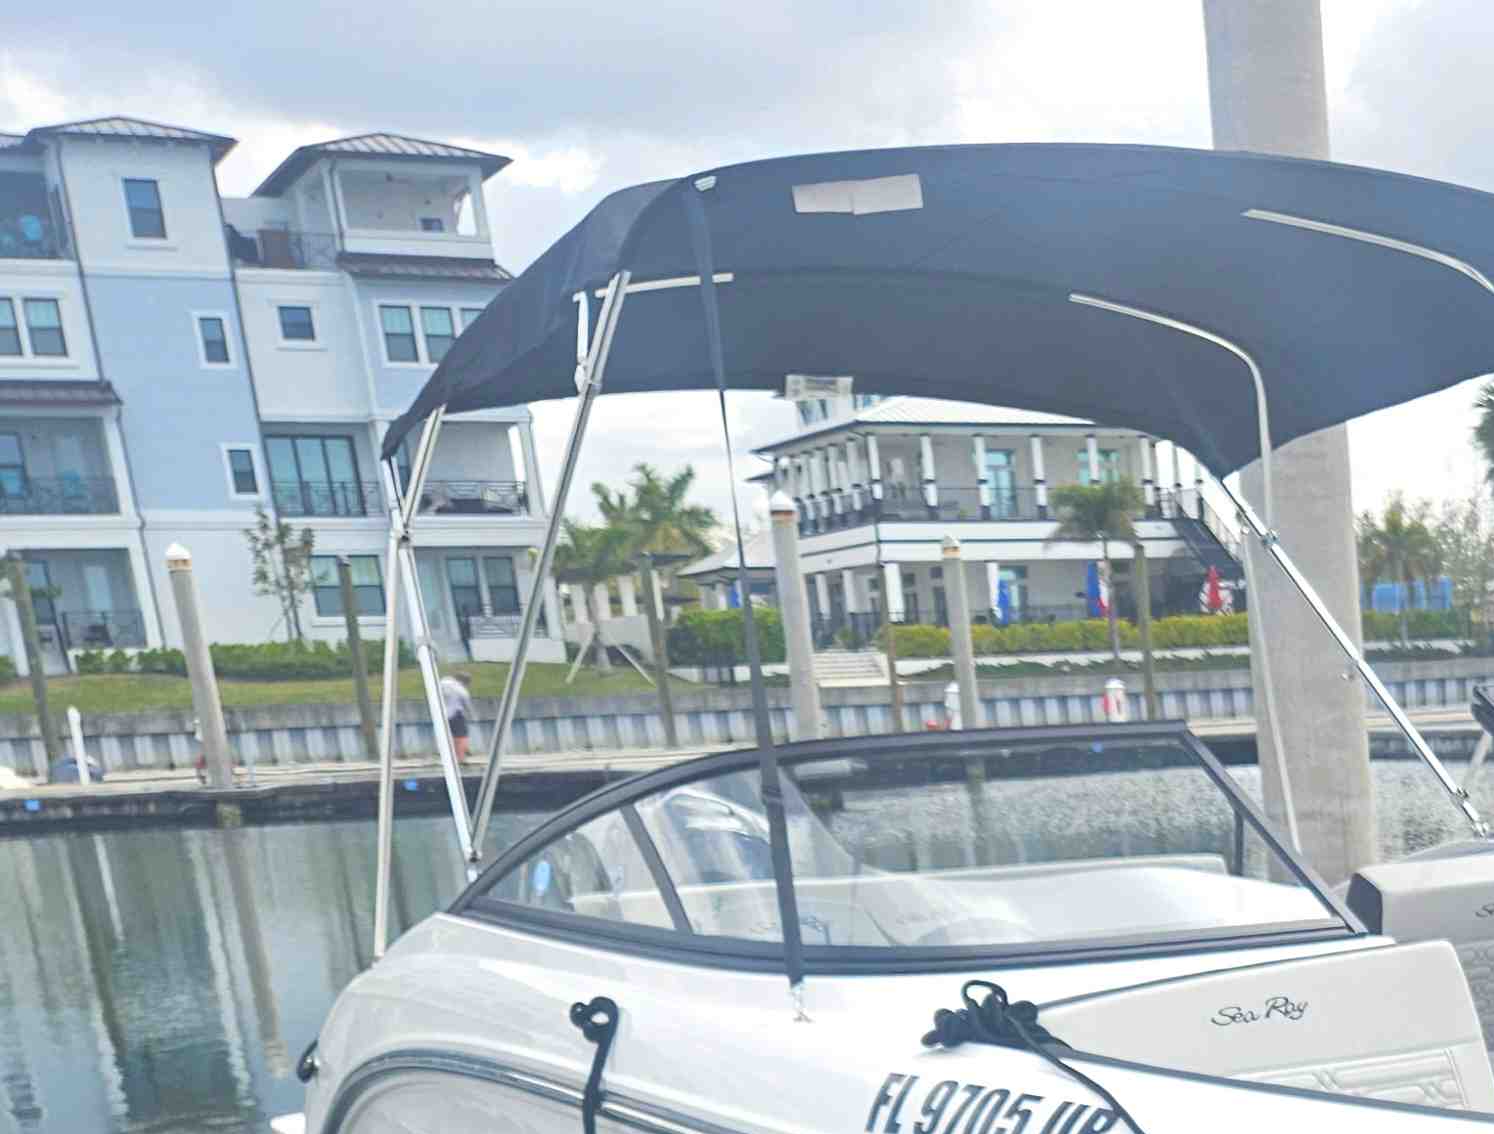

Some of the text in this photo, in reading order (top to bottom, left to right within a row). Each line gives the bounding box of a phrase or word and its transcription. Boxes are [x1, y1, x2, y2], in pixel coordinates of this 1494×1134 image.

[1211, 996, 1308, 1026] Sea Ray
[865, 1072, 919, 1134] FL
